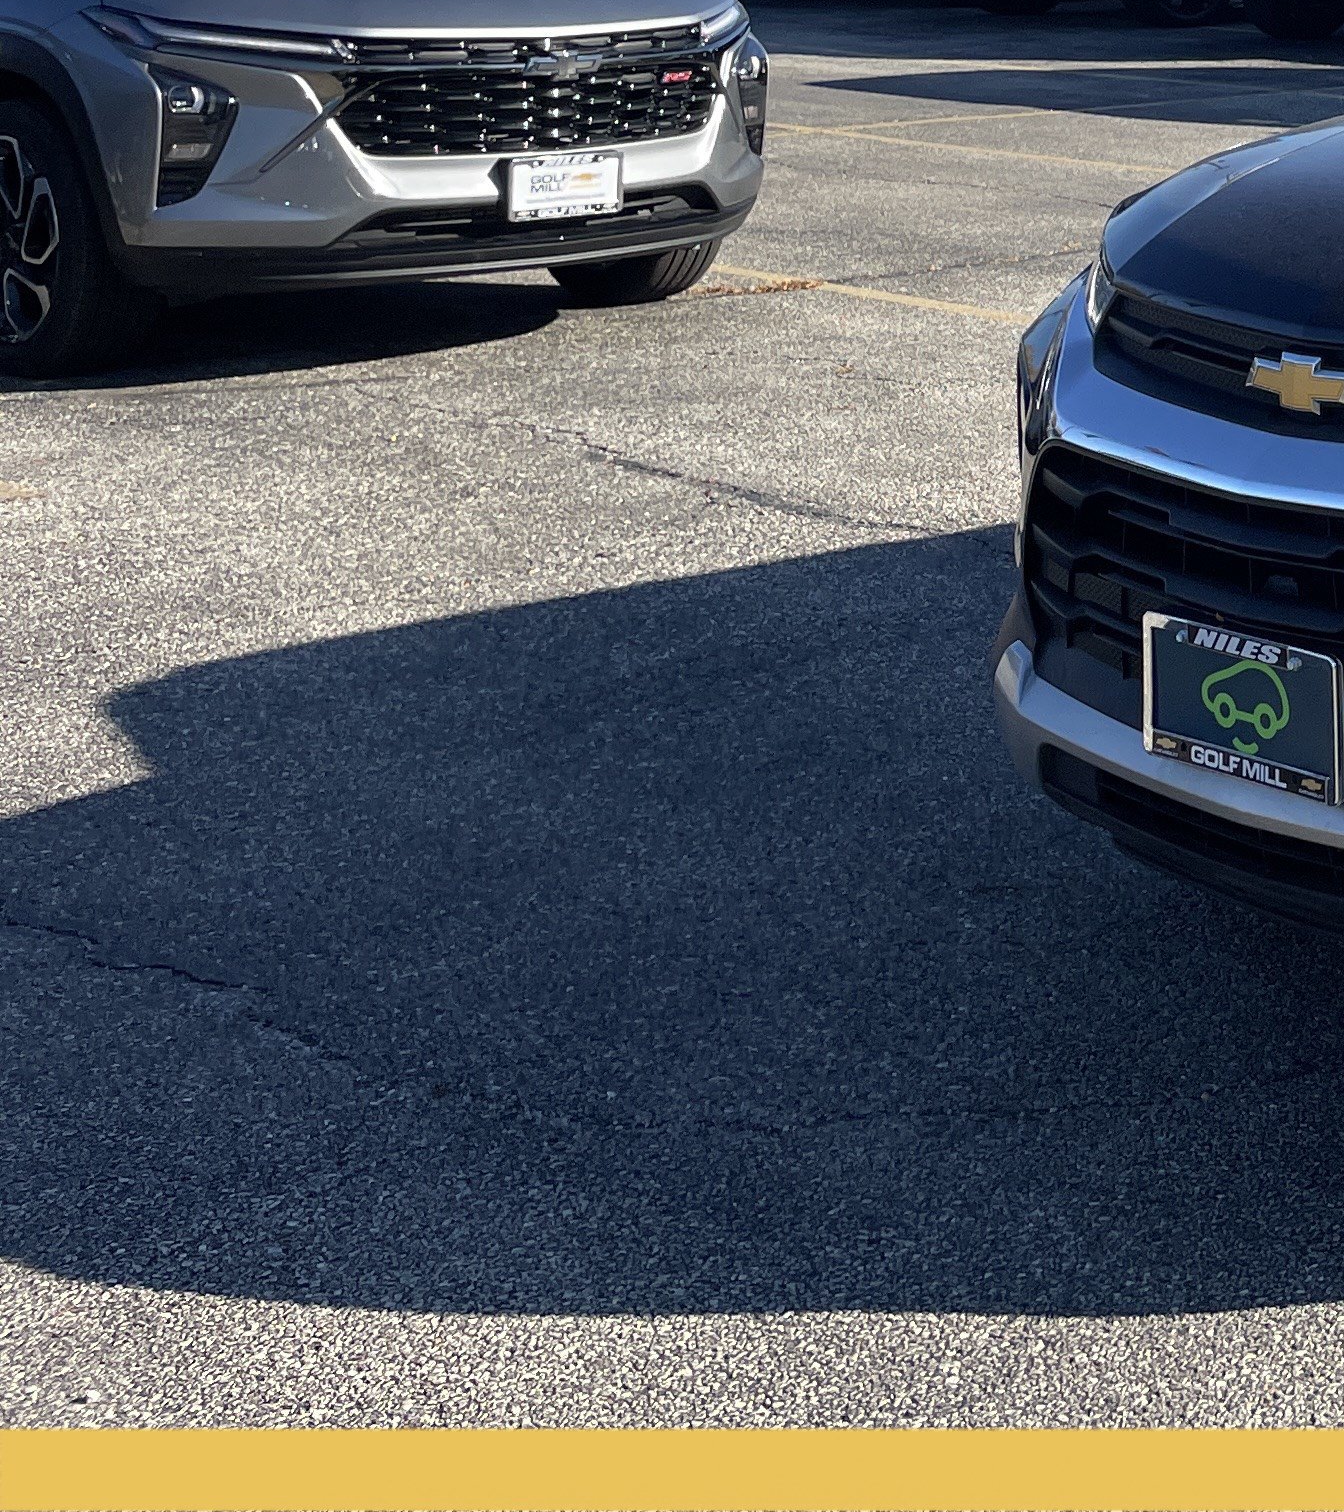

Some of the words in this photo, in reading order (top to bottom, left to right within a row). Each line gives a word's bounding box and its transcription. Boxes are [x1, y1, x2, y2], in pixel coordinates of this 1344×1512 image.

[530, 172, 570, 185] GOLF
[1193, 628, 1281, 664] NILES
[1190, 744, 1241, 774] GOLF
[1242, 757, 1288, 788] MILL
